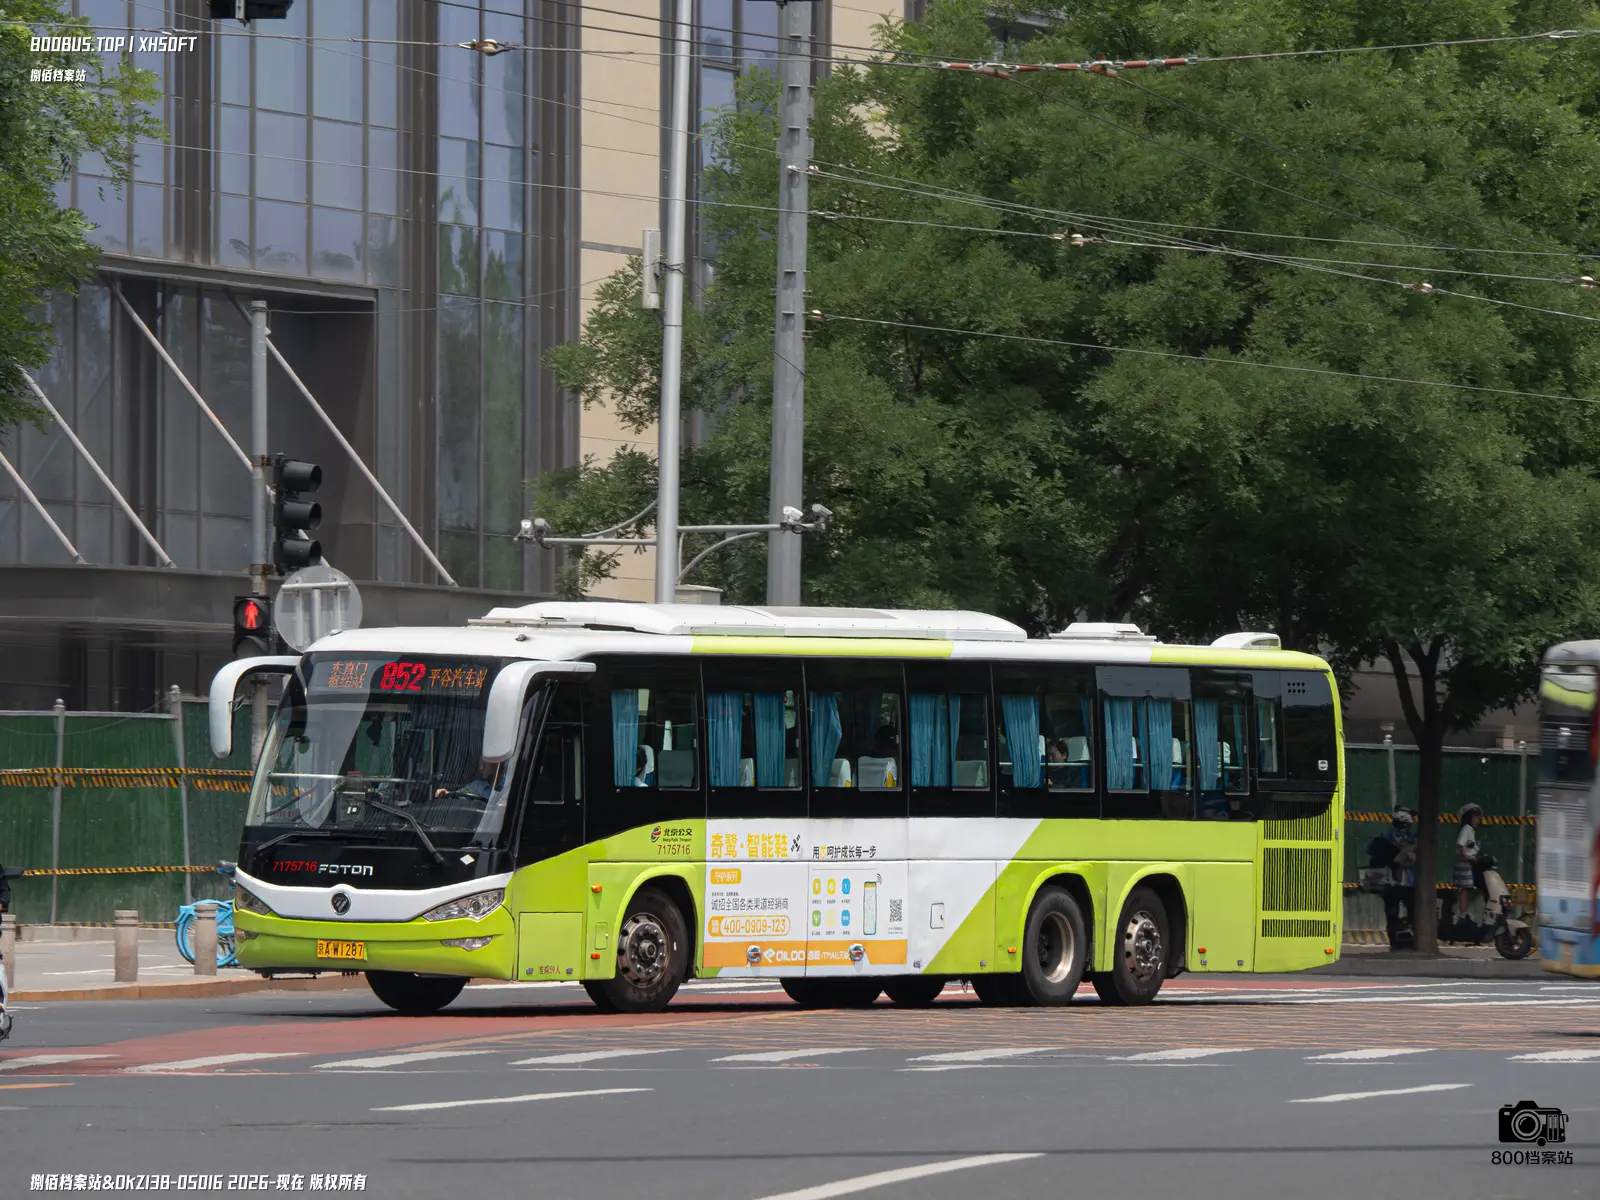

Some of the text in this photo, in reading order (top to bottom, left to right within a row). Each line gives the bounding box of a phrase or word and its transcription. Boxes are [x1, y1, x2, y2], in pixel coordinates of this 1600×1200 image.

[380, 662, 427, 691] 852
[428, 667, 488, 688] 平谷汽车站
[664, 828, 692, 836] 北京公交
[658, 844, 691, 855] 7175716
[273, 861, 317, 872] 7175716
[318, 864, 374, 876] FOTON
[723, 919, 786, 933] 400-0909-123
